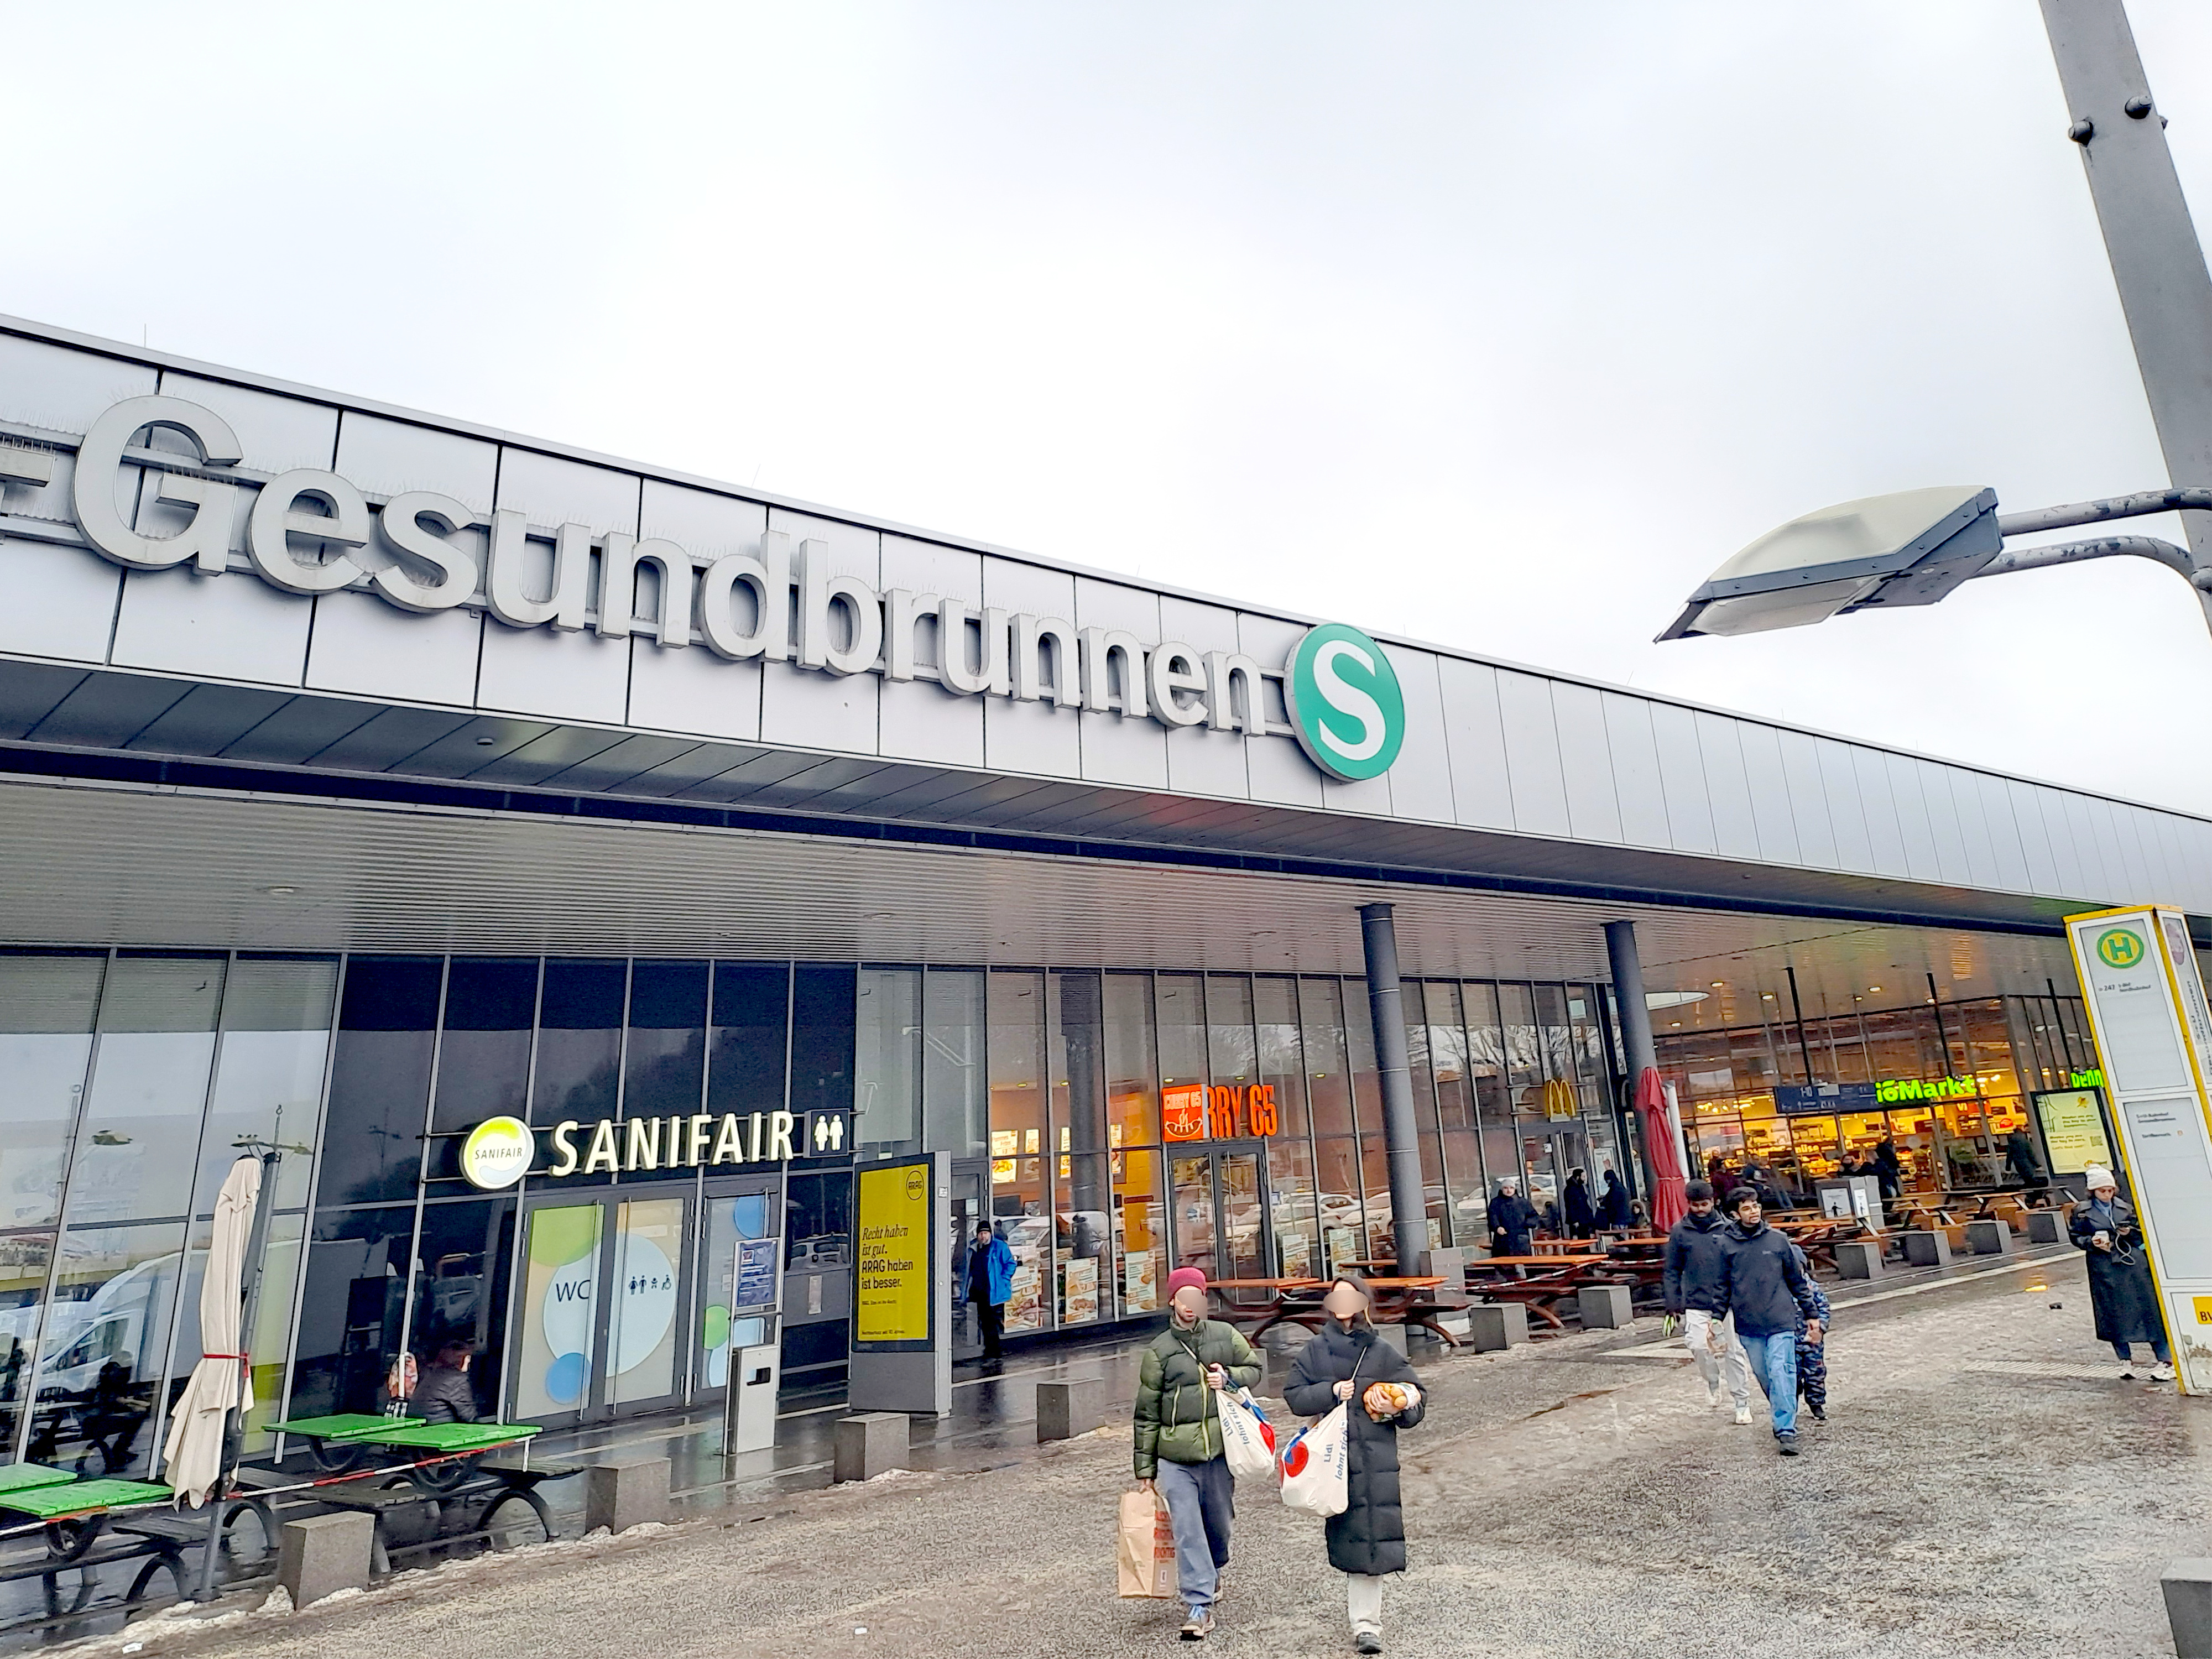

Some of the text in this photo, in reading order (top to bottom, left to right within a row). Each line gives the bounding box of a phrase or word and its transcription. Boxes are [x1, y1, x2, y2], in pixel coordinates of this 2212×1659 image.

[1313, 639, 1386, 761] S
[2107, 937, 2133, 960] H
[1190, 1091, 1202, 1108] 65
[1249, 1084, 1277, 1136] 65
[550, 1110, 794, 1177] SANIFAIR
[475, 1147, 522, 1160] SANIFAIR
[908, 1181, 922, 1190] ARAG
[862, 1224, 909, 1241] Recht haben
[862, 1244, 888, 1258] ist gut.
[862, 1258, 913, 1274] ARAG haben
[556, 1280, 591, 1302] WC
[862, 1277, 902, 1290] ist besser.
[1235, 1421, 1250, 1444] lohnt
[1324, 1443, 1333, 1462] Lidl
[1334, 1452, 1345, 1480] lohnt
